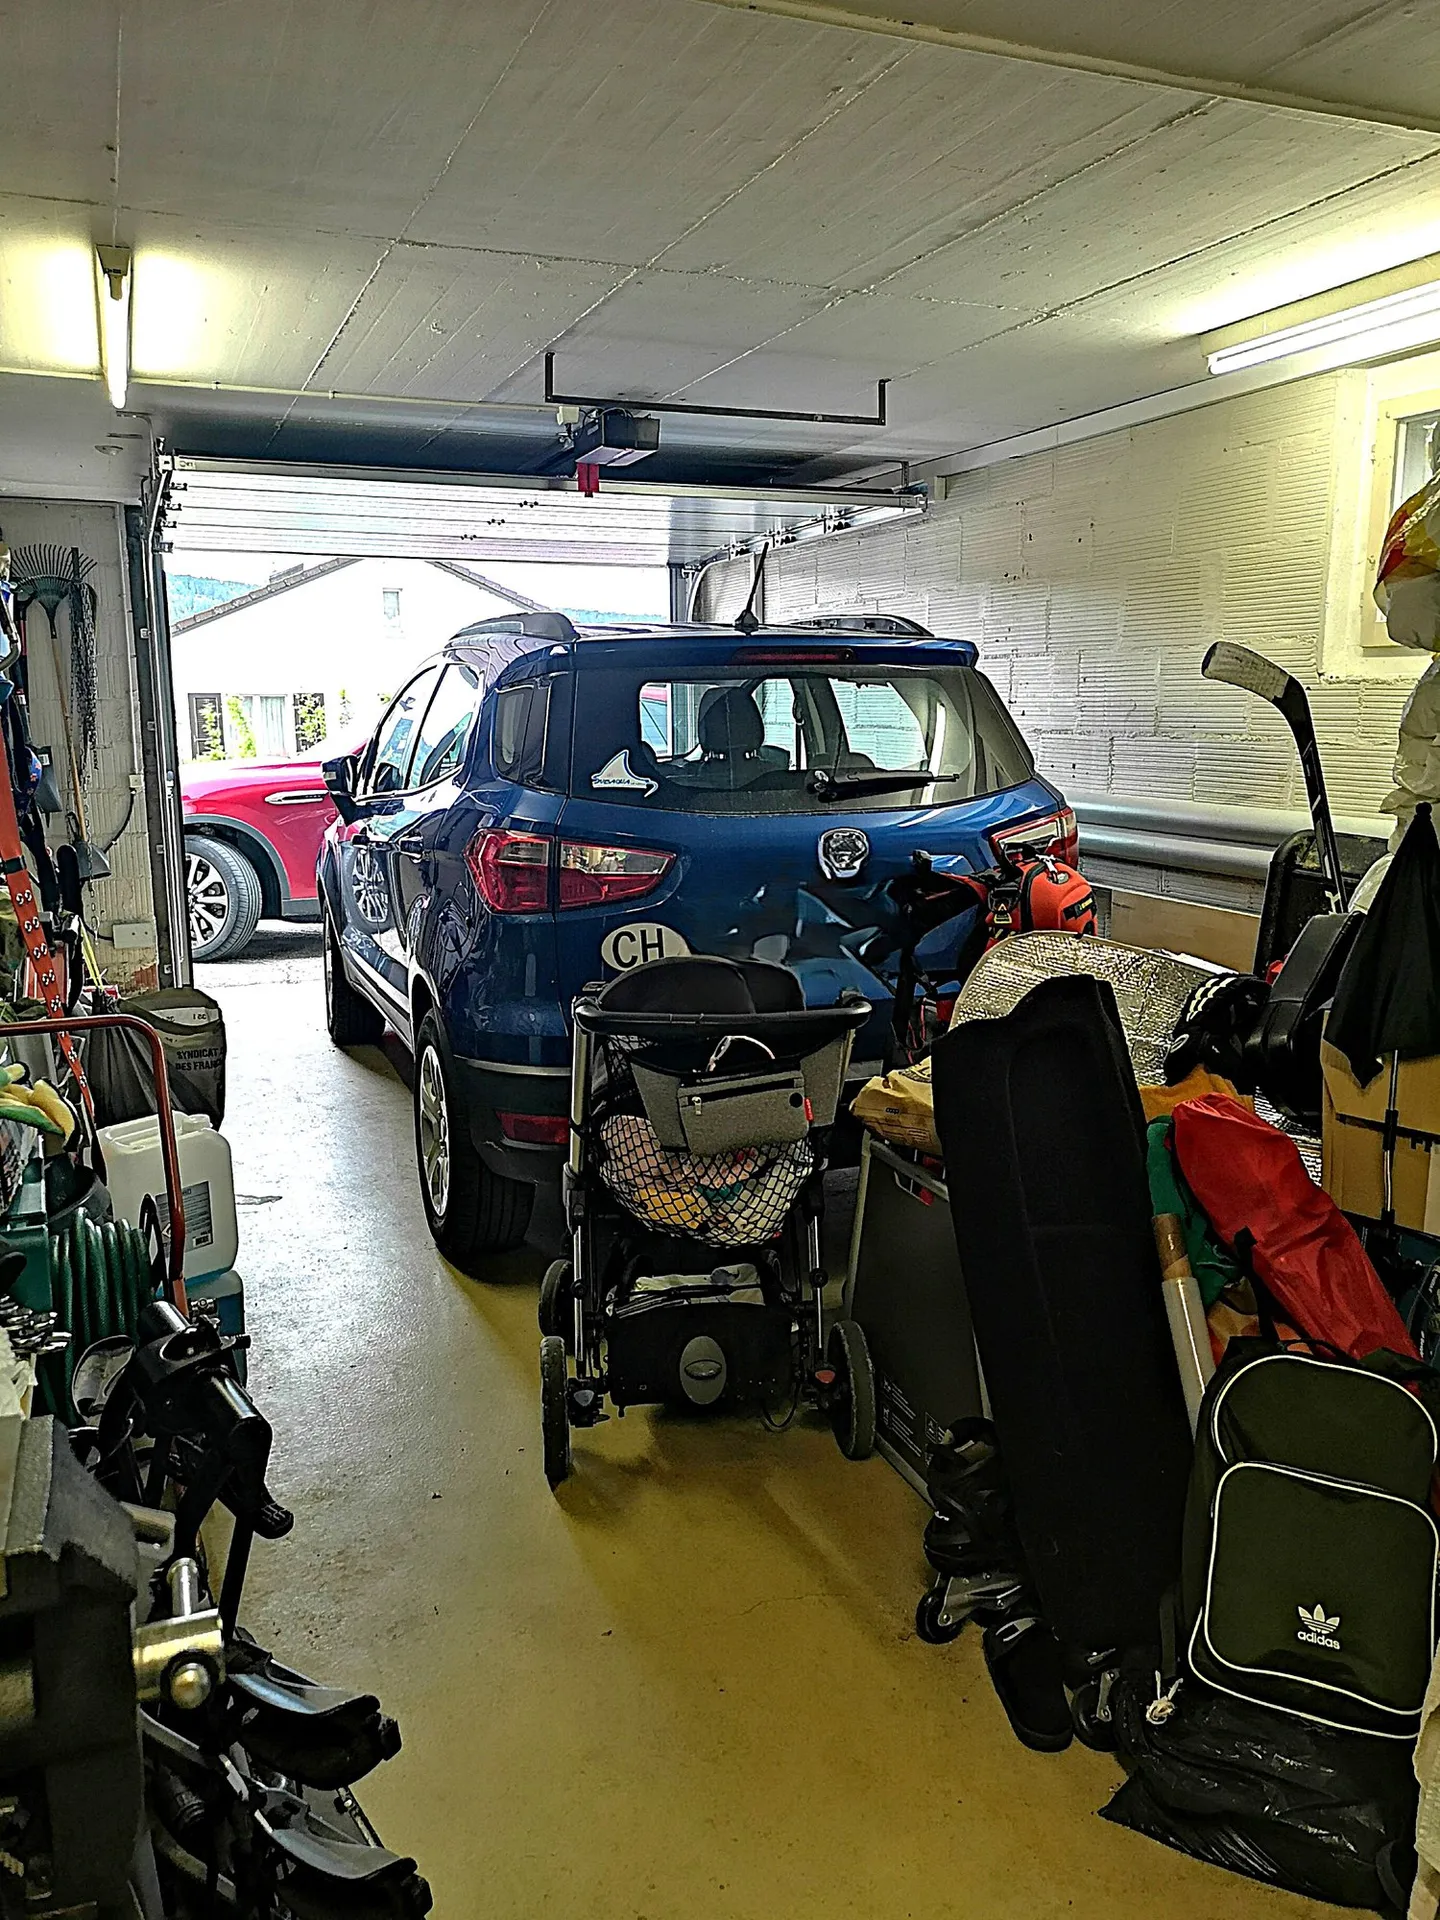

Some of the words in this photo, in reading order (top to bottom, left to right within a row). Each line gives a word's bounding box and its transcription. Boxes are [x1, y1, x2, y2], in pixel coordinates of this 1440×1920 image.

[612, 928, 665, 968] CH
[176, 1048, 219, 1059] SYNDICAT
[175, 1062, 192, 1071] DES
[1297, 1631, 1340, 1650] adidas
